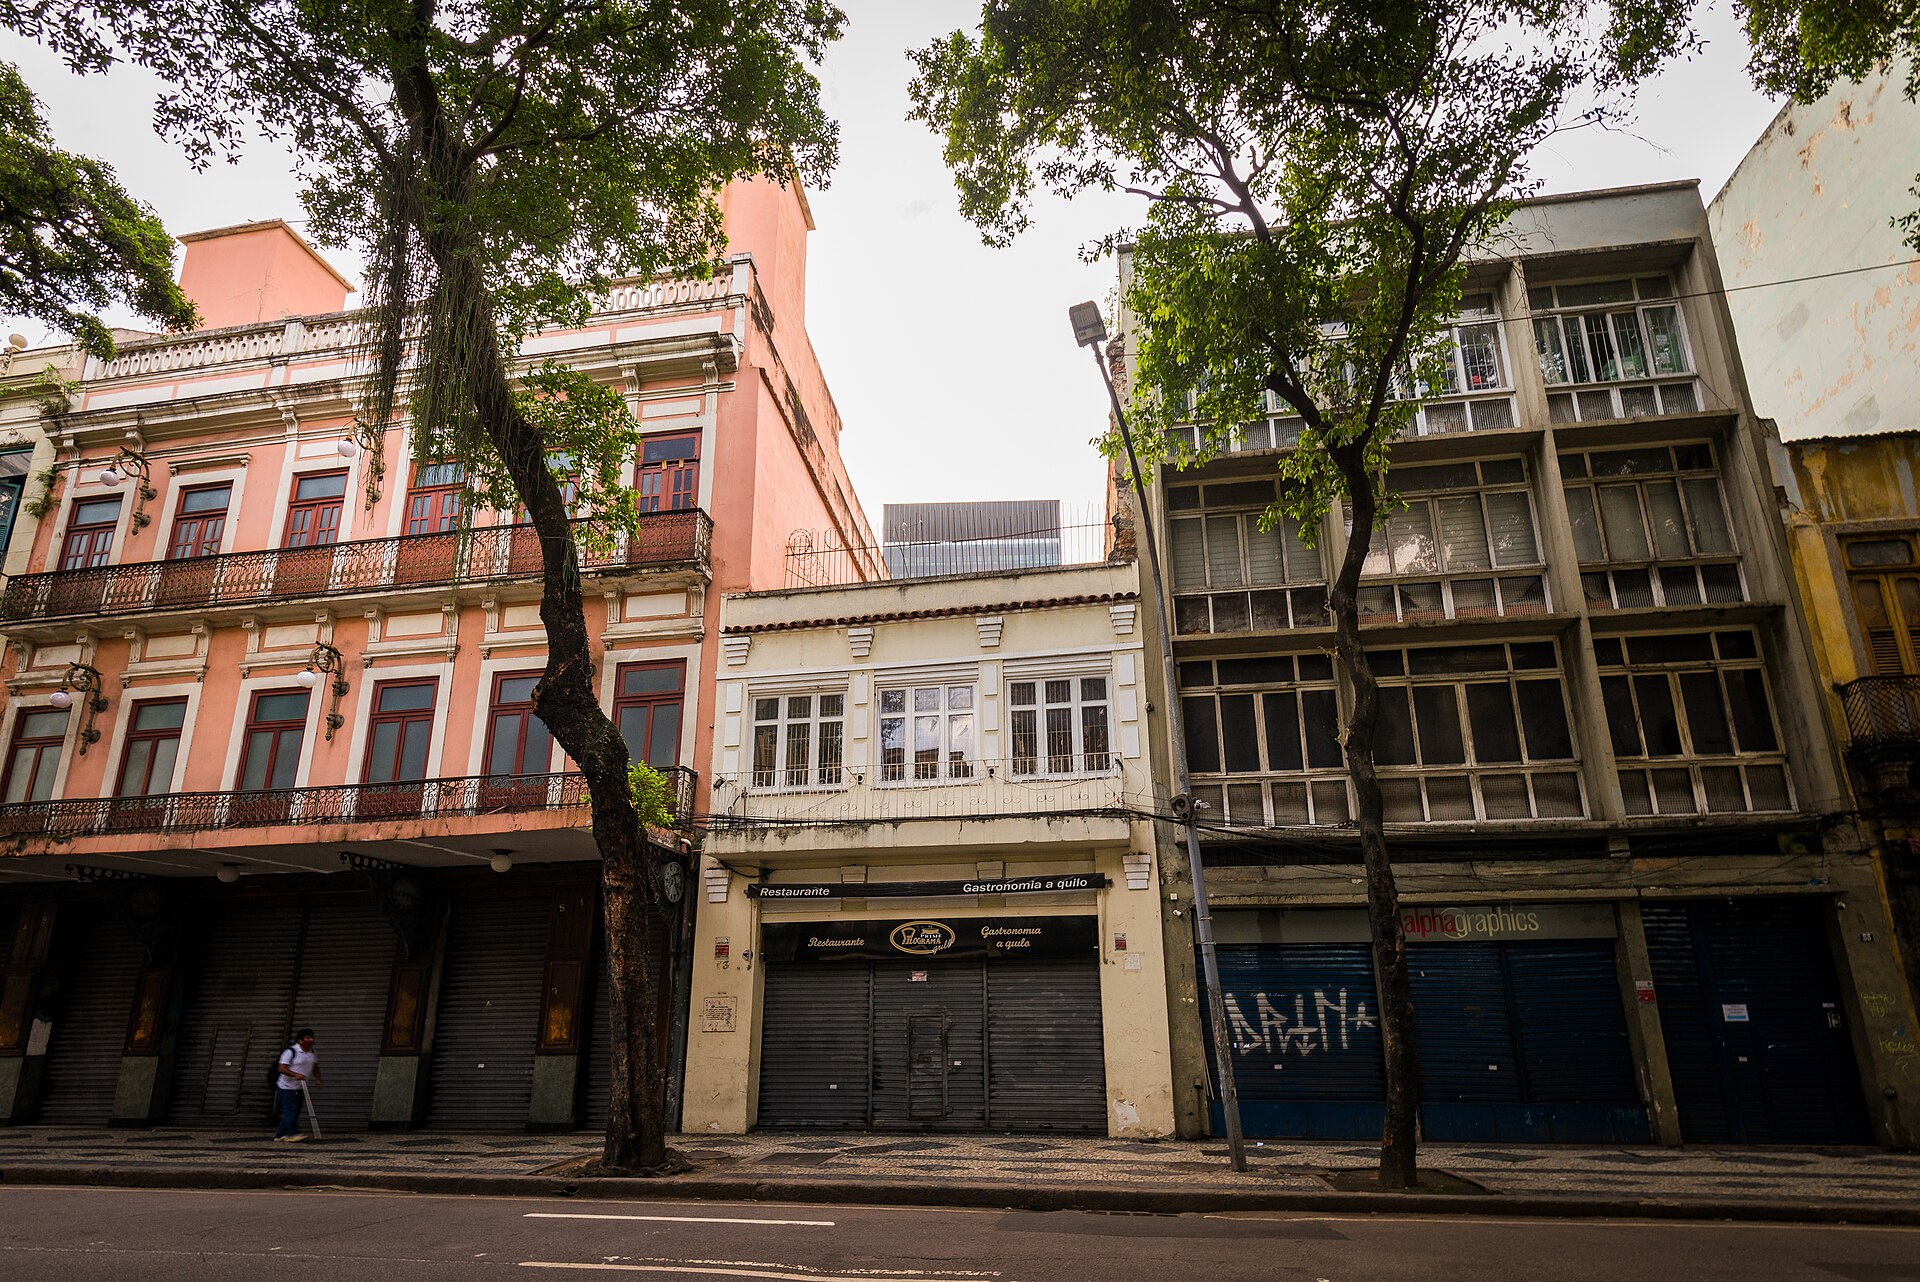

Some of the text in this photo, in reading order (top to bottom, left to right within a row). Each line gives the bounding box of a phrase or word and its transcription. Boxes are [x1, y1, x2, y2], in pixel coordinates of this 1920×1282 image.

[963, 878, 1088, 892] Gastronomia a quilo
[760, 887, 830, 897] Restaurante
[1404, 906, 1540, 938] alphagraphics
[981, 925, 1042, 939] Gastronomia
[807, 936, 865, 948] Restaurante
[1005, 938, 1030, 950] quilo
